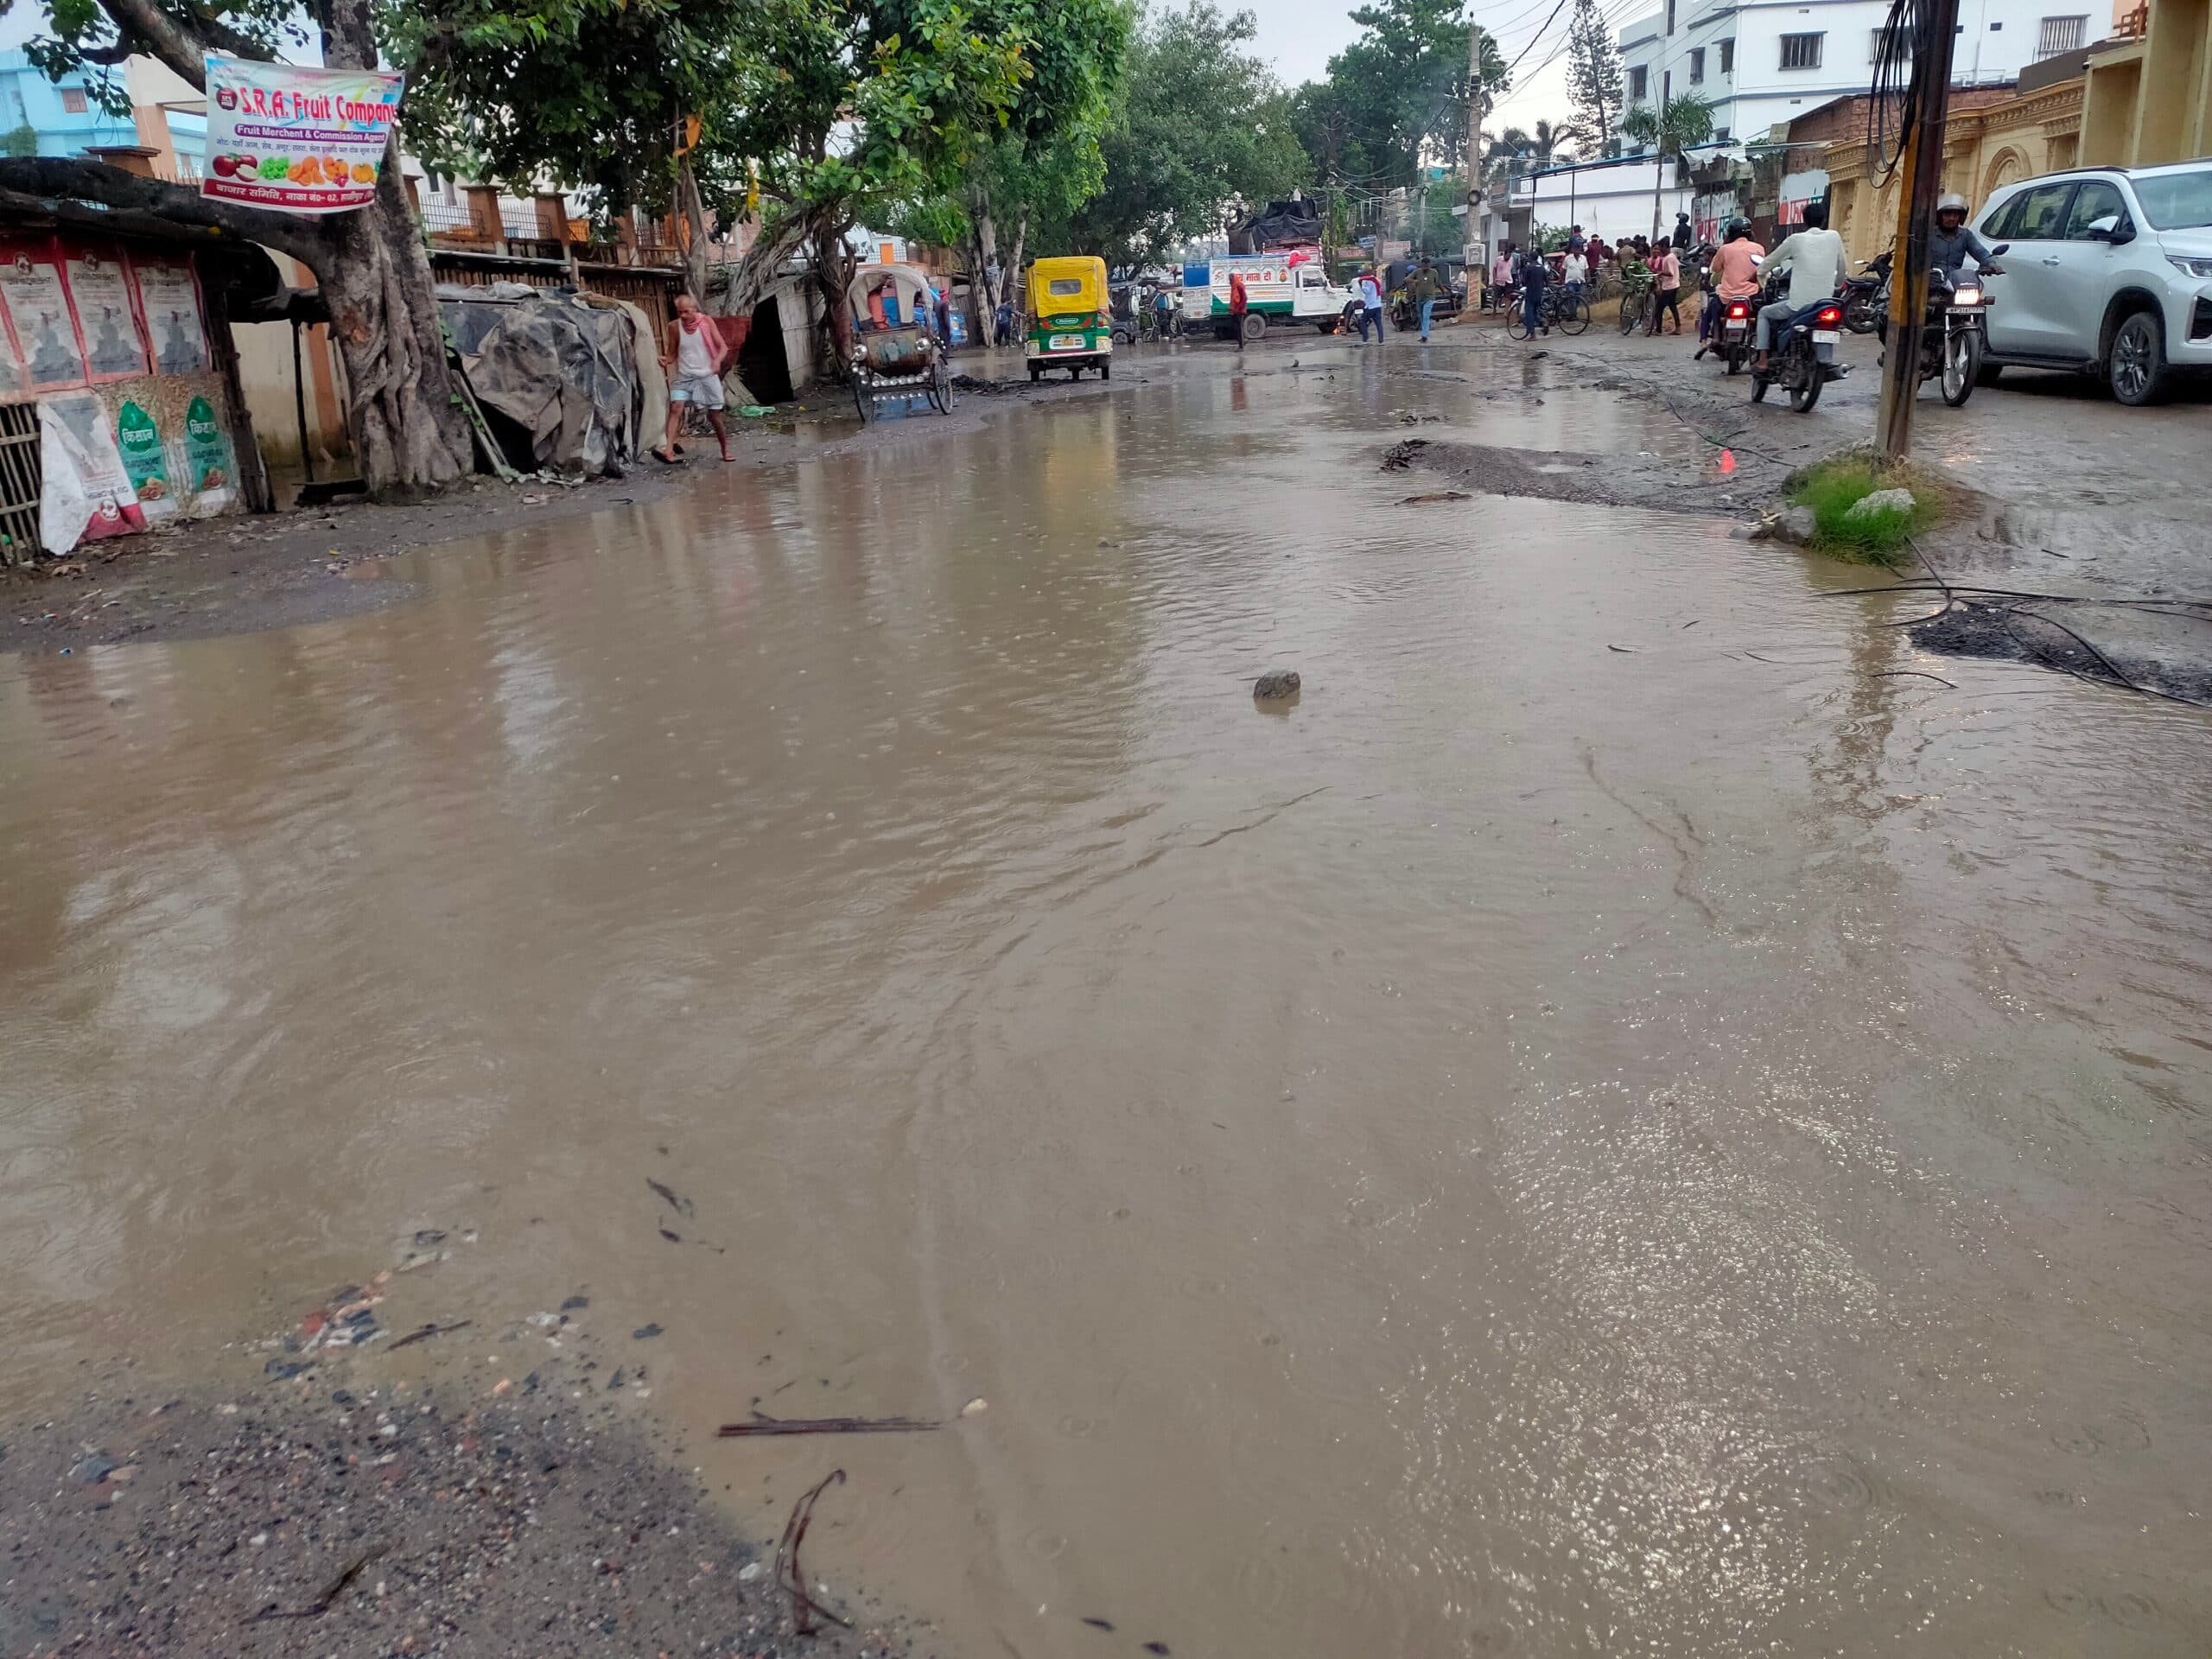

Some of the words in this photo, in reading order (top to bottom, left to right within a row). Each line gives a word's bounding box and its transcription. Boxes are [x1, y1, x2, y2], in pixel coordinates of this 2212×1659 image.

[239, 87, 289, 118] S.R.A.
[292, 91, 331, 119] Fruit
[237, 125, 261, 136] Fruit
[305, 130, 312, 138] &
[314, 130, 363, 141] Commission
[364, 133, 385, 143] Agent
